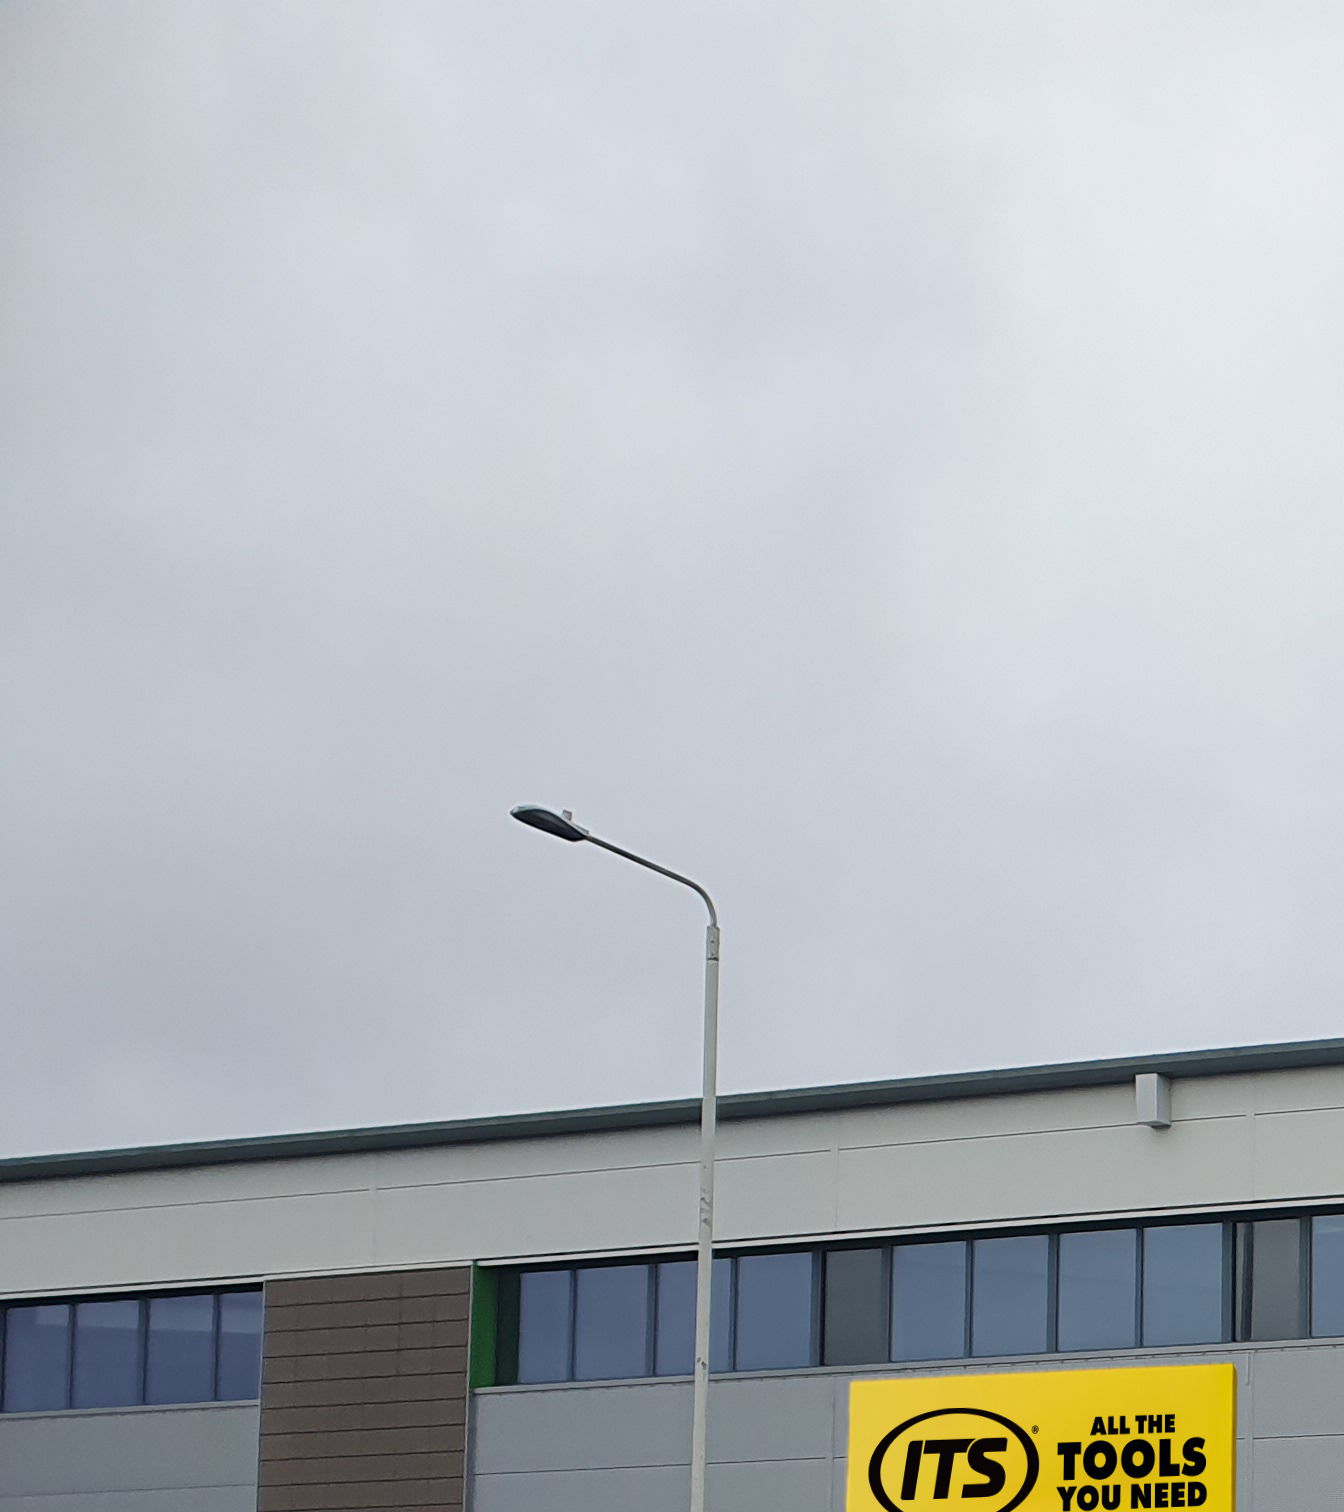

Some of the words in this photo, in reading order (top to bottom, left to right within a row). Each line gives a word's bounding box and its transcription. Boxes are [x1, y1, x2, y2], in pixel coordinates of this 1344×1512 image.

[1090, 1416, 1130, 1435] ALL
[1135, 1414, 1175, 1434] THE
[901, 1438, 1007, 1500] ITS
[1058, 1437, 1206, 1480] TOOLS
[1057, 1485, 1120, 1511] YOU
[1131, 1482, 1207, 1509] NEED
